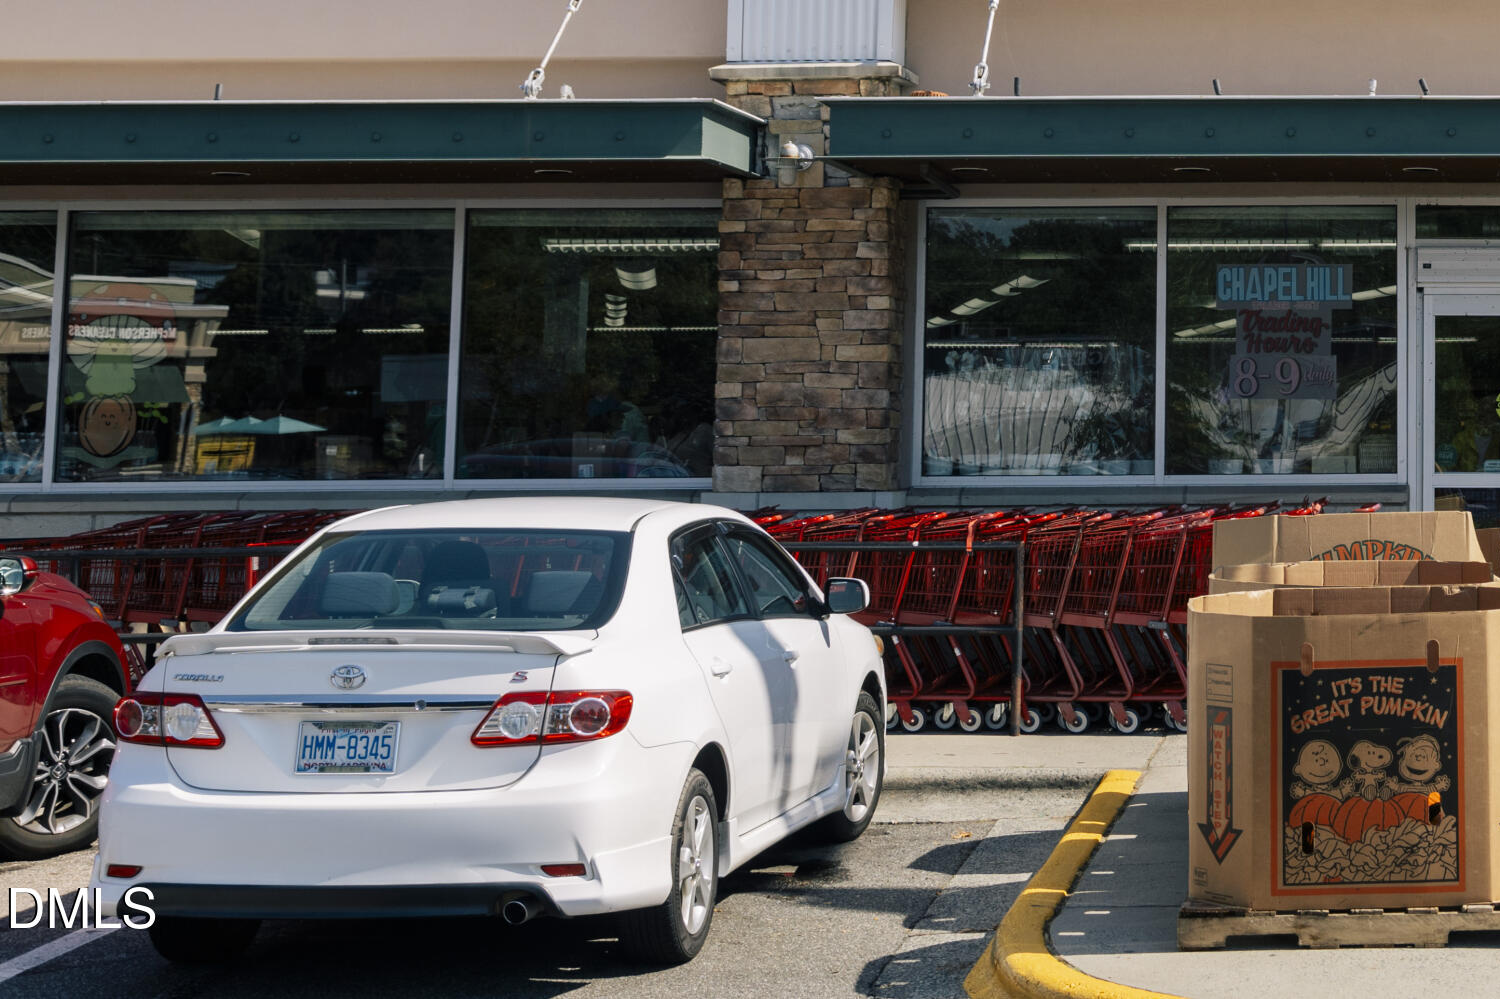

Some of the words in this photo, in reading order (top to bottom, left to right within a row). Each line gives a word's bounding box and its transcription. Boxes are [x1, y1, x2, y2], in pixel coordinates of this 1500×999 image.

[1217, 266, 1304, 302] CHAPEL
[1306, 266, 1351, 302] HILL
[1238, 309, 1330, 338] Trading
[1243, 333, 1318, 354] Hours
[1233, 357, 1301, 397] 8-9
[1331, 676, 1363, 698] IT'S
[1368, 675, 1406, 694] THE
[1290, 698, 1354, 735] GREAT
[1360, 695, 1449, 729] PUMPKIN
[301, 735, 392, 760] HMM-8345
[1213, 729, 1223, 781] WATCH
[1213, 790, 1222, 829] STEP
